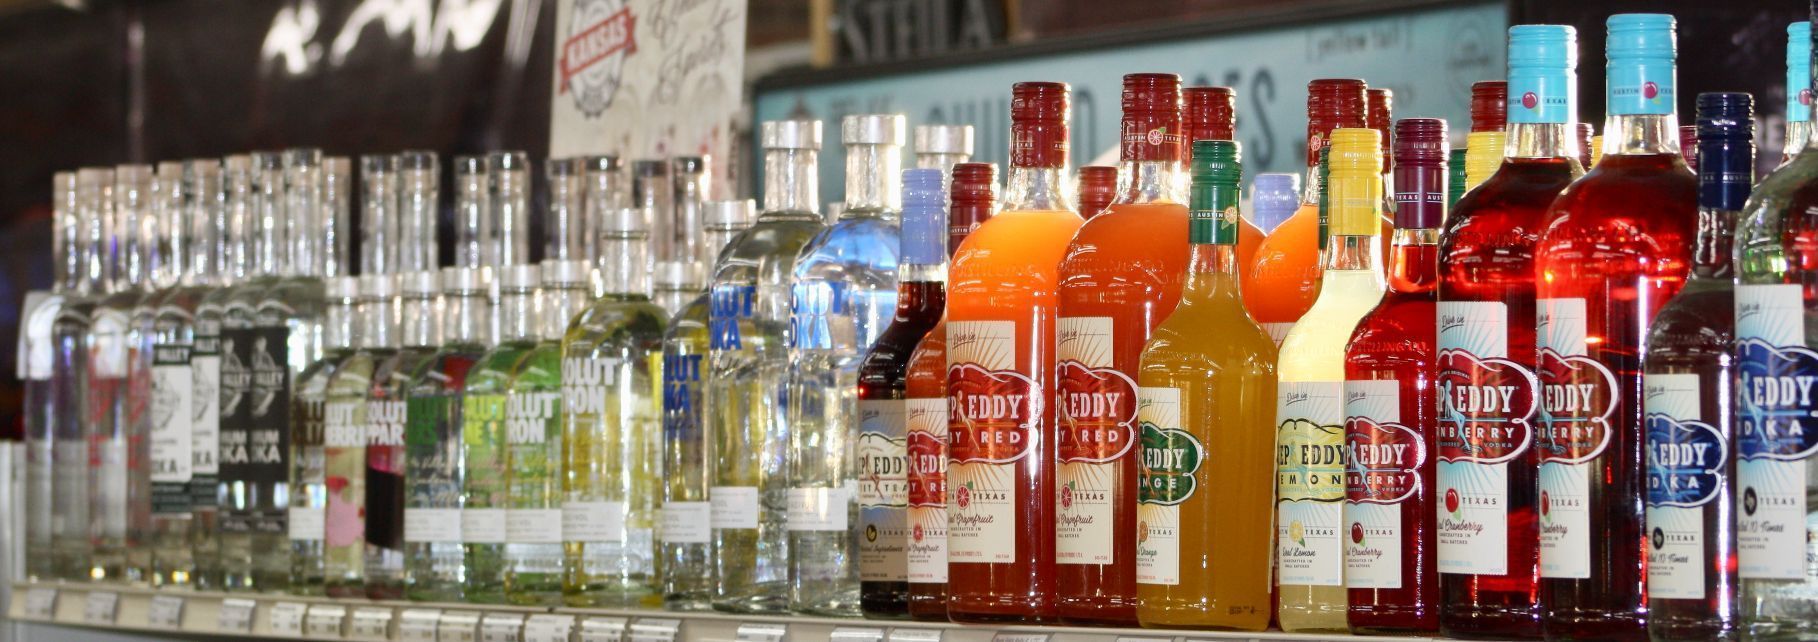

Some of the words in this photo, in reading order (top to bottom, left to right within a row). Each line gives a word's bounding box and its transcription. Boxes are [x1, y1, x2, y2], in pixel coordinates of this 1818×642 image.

[1457, 385, 1516, 413] EDDY
[1546, 383, 1594, 412] EDDY
[1753, 376, 1814, 406] EDDY
[967, 394, 1023, 419] EDDY
[1070, 393, 1120, 418] EDDY
[980, 431, 1021, 444] RED
[1081, 430, 1119, 443] RED
[1146, 448, 1185, 469] EDDY
[1301, 444, 1344, 465] EDDY
[1359, 443, 1405, 465] EDDY
[1660, 443, 1708, 466] EDDY
[1462, 497, 1497, 505] TEXAS
[1444, 518, 1484, 535] Cranberry
[1293, 546, 1316, 557] Lemon
